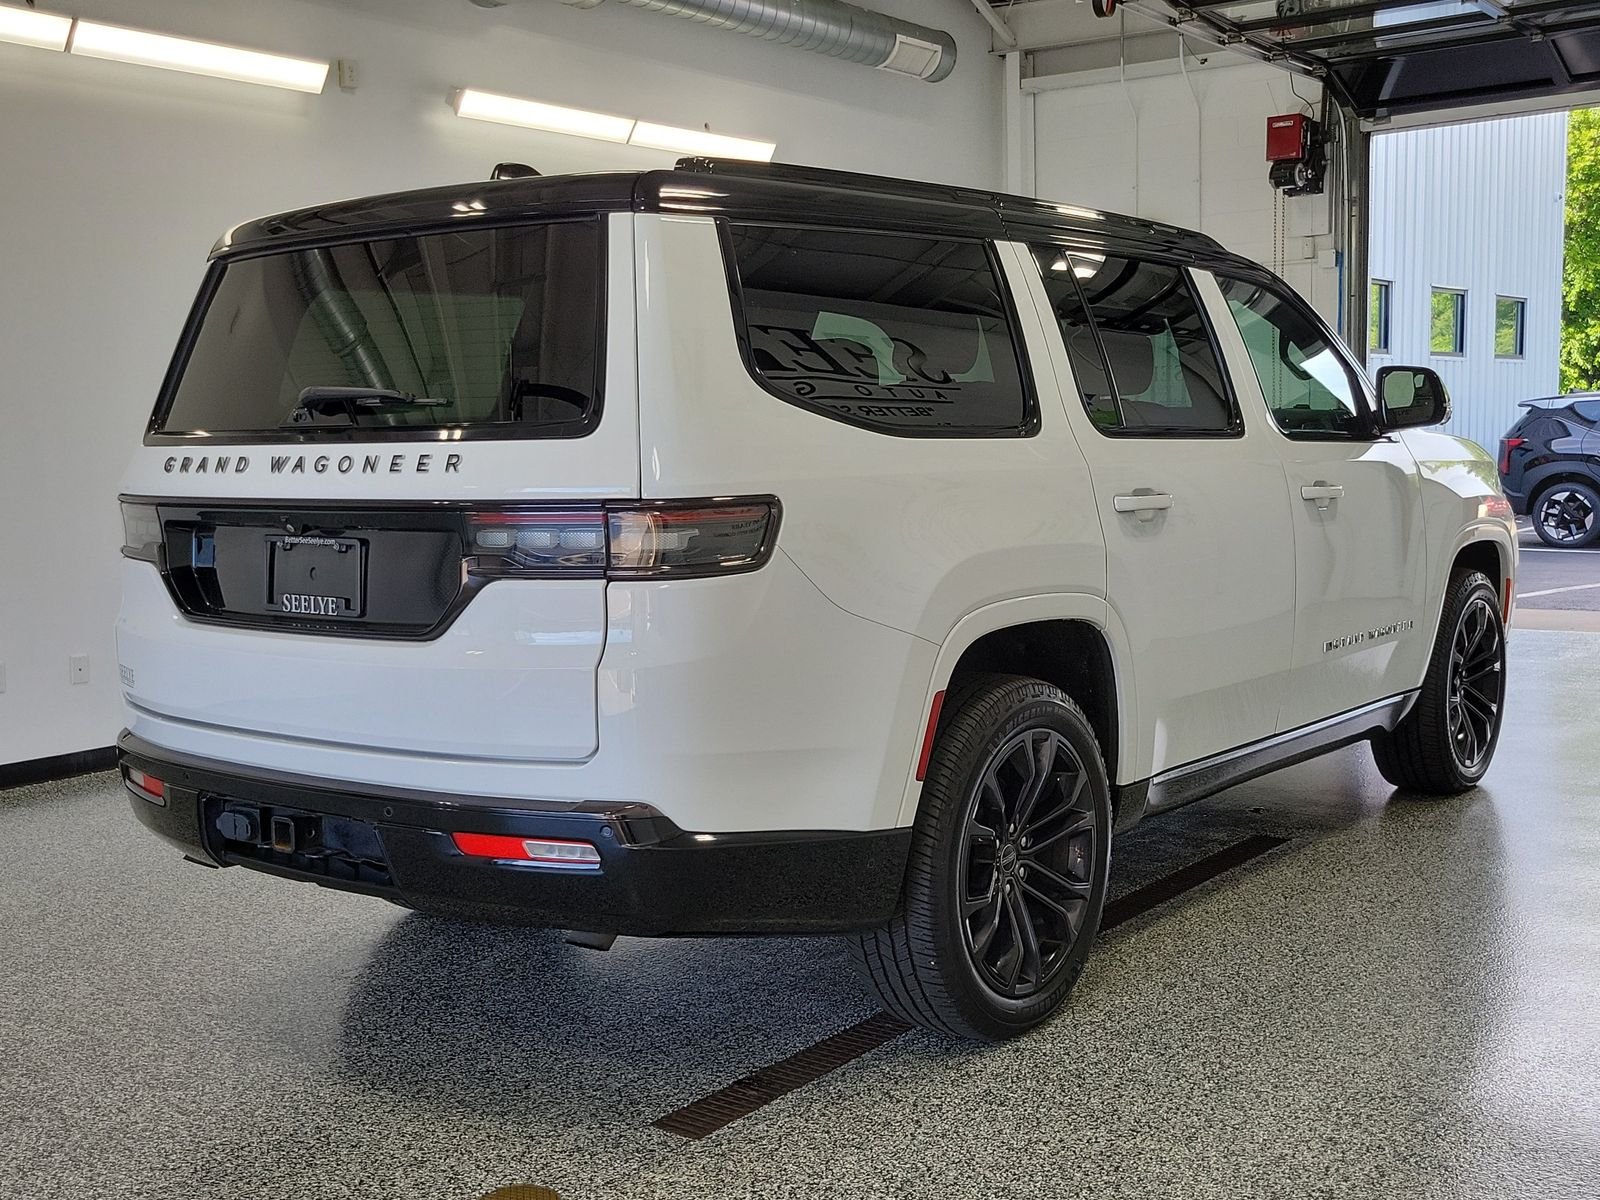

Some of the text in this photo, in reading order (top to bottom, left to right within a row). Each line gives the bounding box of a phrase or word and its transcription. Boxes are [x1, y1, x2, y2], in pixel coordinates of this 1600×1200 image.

[163, 453, 464, 474] GRAND WAGONEER
[282, 592, 338, 617] SEELYE
